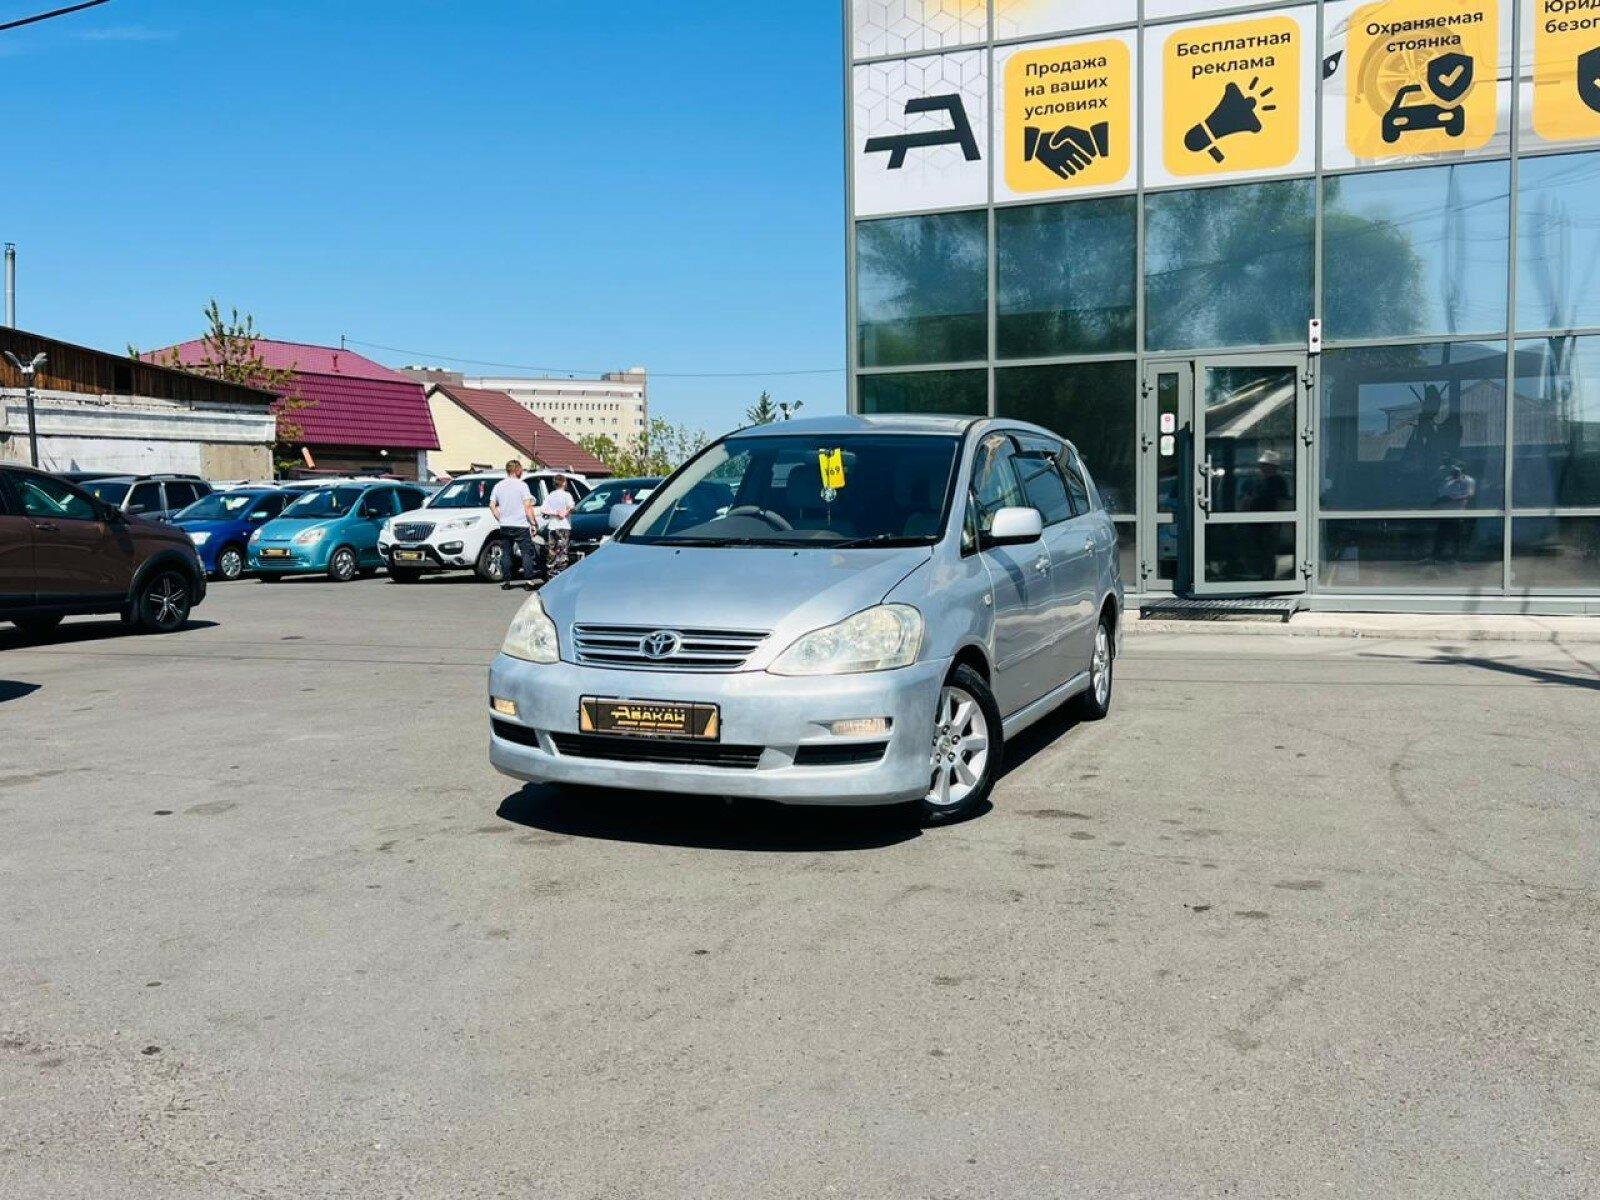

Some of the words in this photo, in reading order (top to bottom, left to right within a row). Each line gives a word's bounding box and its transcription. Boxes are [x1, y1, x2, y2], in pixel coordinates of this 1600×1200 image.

[1366, 12, 1483, 36] Охраняемая
[1177, 32, 1291, 57] Бесплатная
[1387, 34, 1461, 53] стоянка
[1025, 56, 1107, 78] Продажа
[1192, 55, 1275, 79] реклама
[1025, 85, 1045, 97] на
[1051, 77, 1107, 94] ваших
[1024, 98, 1107, 120] условиях
